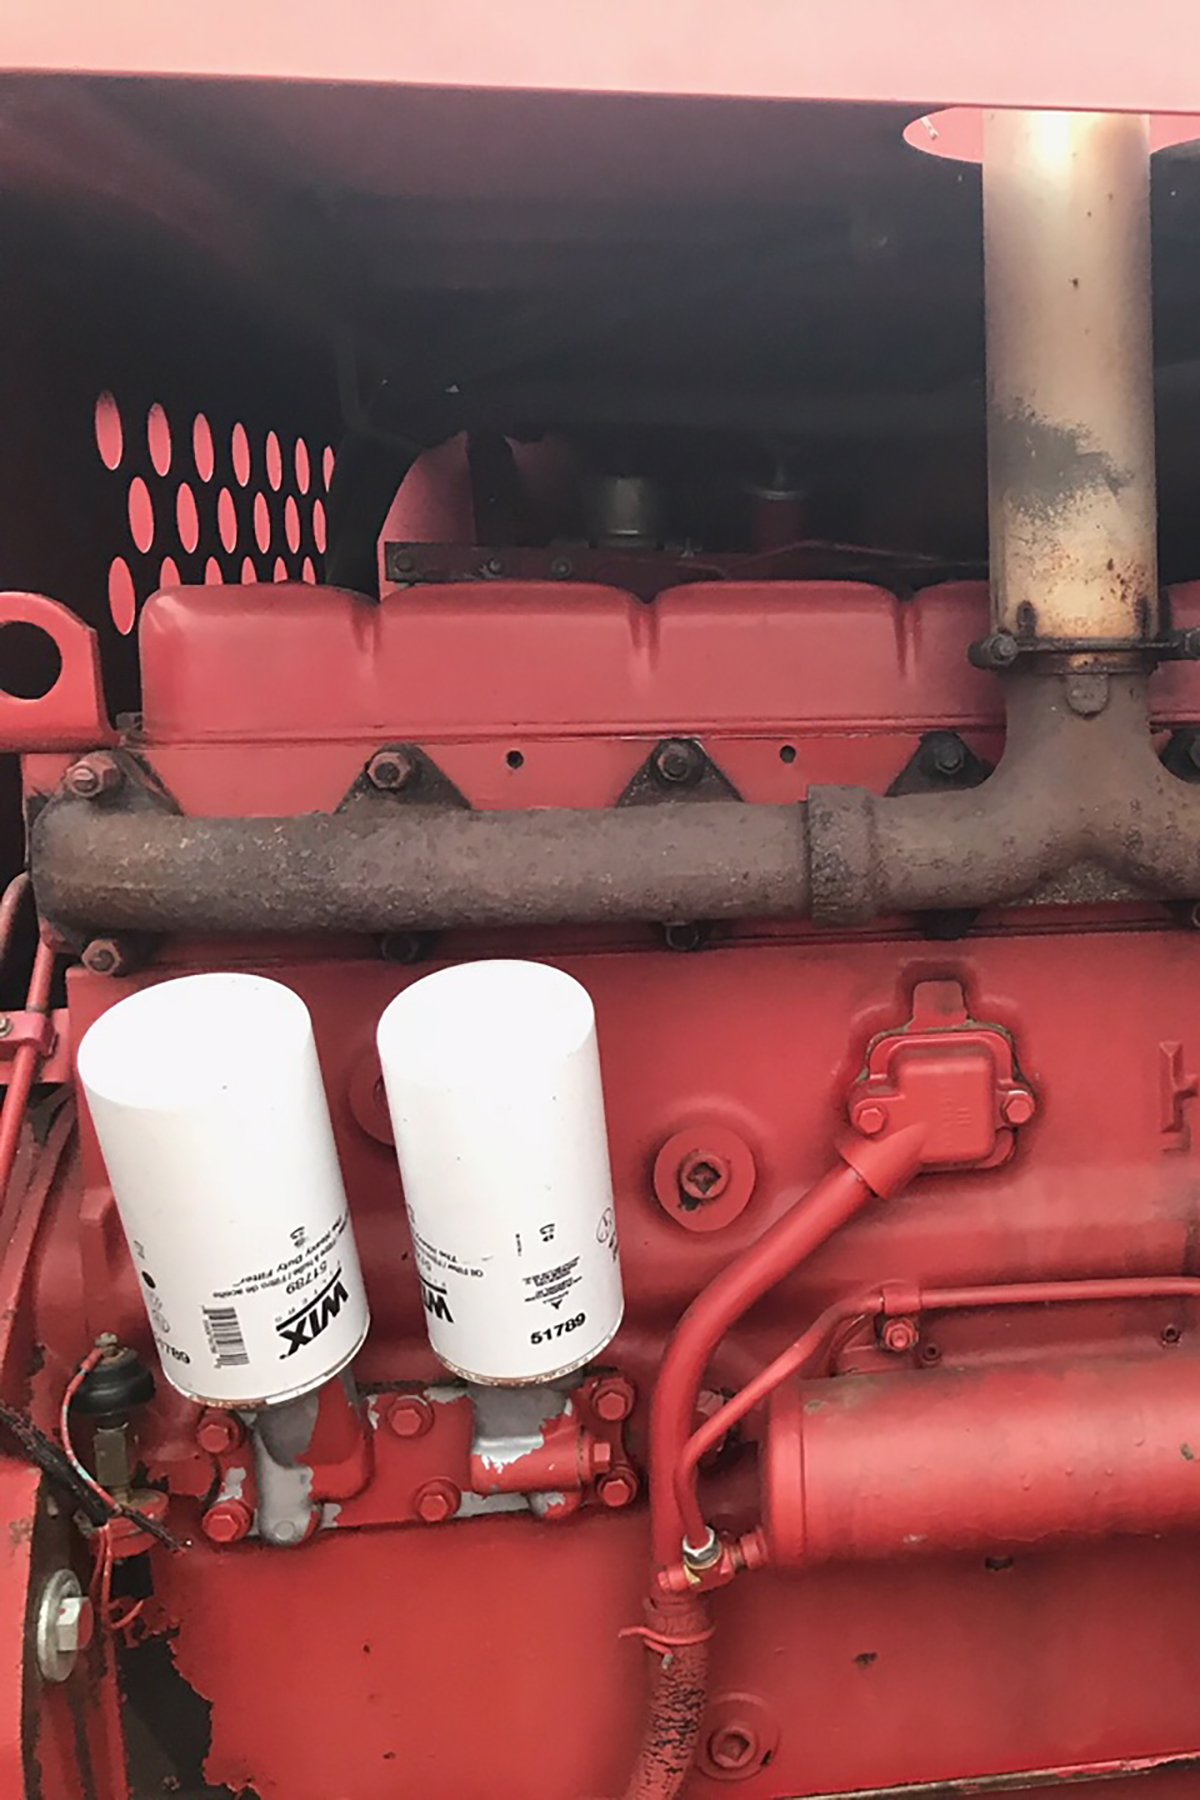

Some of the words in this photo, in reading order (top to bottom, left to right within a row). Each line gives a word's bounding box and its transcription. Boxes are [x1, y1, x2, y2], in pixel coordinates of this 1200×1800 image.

[276, 1254, 303, 1273] Duty
[286, 1260, 328, 1295] 51789
[279, 1280, 349, 1357] WIX
[530, 1312, 587, 1345] 51789
